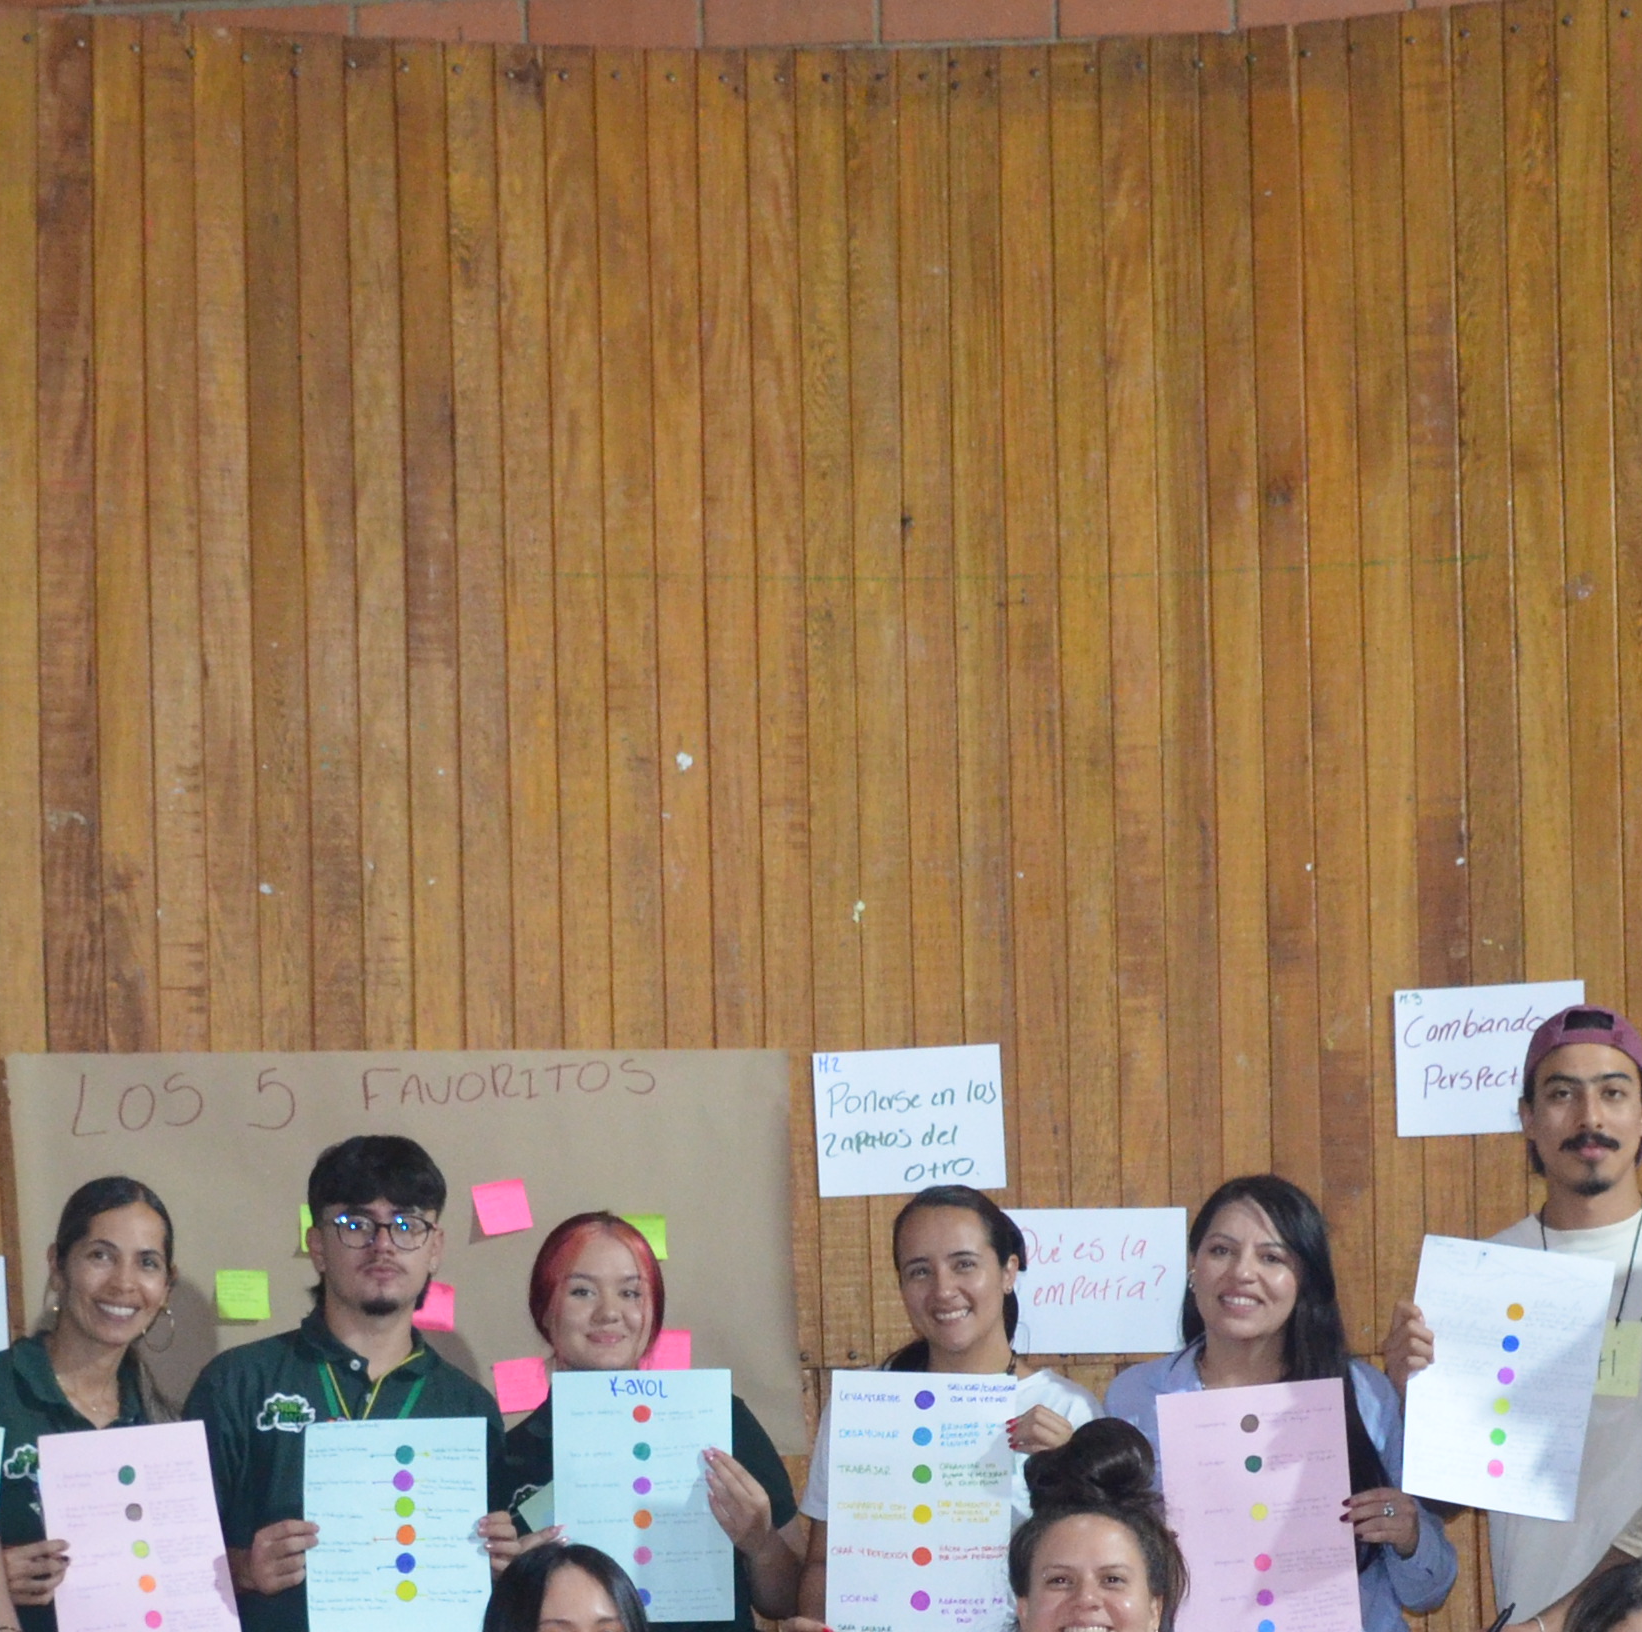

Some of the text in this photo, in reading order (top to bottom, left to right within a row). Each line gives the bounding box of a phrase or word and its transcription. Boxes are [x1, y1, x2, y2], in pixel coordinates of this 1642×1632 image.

[71, 1058, 657, 1138] LOS 5 FAVORITOS
[826, 1078, 997, 1119] Ponerse en los
[1423, 1062, 1521, 1099] Perspect
[920, 1123, 959, 1149] del
[1072, 1235, 1106, 1262] es
[1120, 1234, 1148, 1262] la
[1031, 1265, 1167, 1307] empatía?
[609, 1375, 668, 1399] Karol
